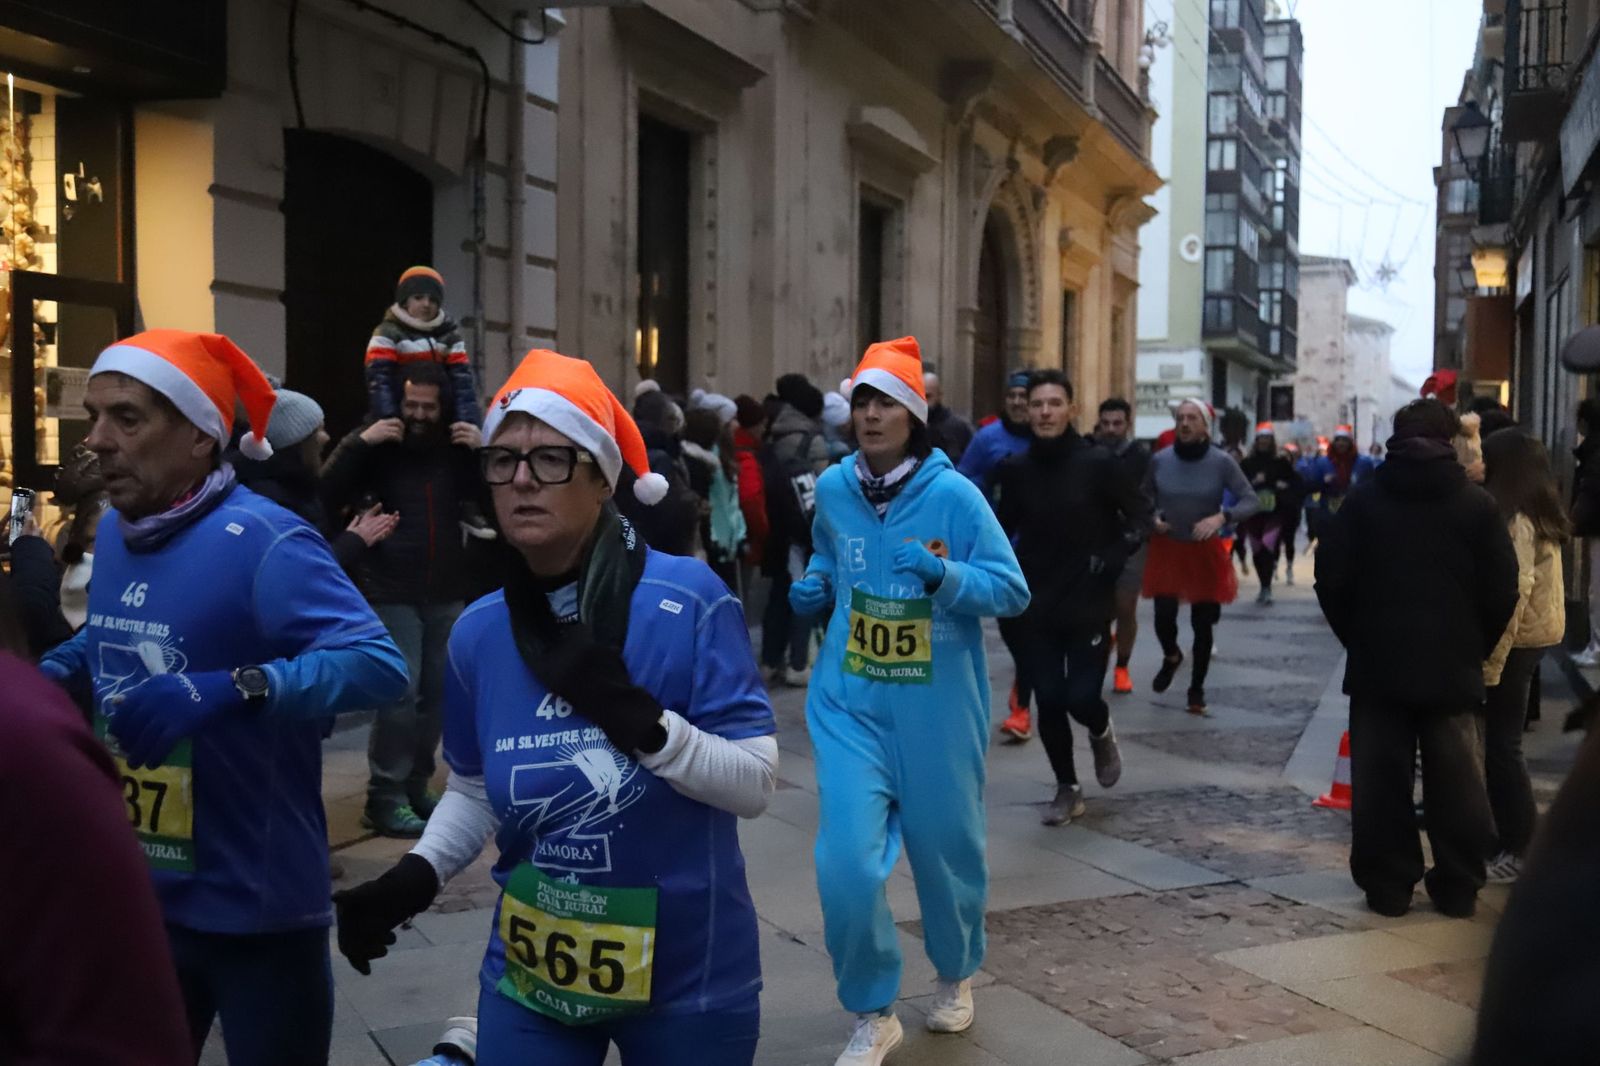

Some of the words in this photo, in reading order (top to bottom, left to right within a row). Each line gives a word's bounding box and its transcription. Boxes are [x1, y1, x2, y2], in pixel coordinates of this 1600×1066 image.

[121, 581, 149, 608] 46
[90, 613, 104, 627] SAN
[104, 616, 146, 634] SILVESTRE
[853, 617, 918, 657] 405
[866, 664, 889, 678] CAJA
[890, 667, 927, 678] RURAL
[535, 693, 573, 720] 46
[495, 737, 515, 752] SAN
[518, 729, 580, 749] SILVESTRE
[537, 891, 561, 910] CAJA
[565, 901, 608, 915] RURAL
[508, 914, 627, 995] 565
[535, 988, 572, 1016] CAJA
